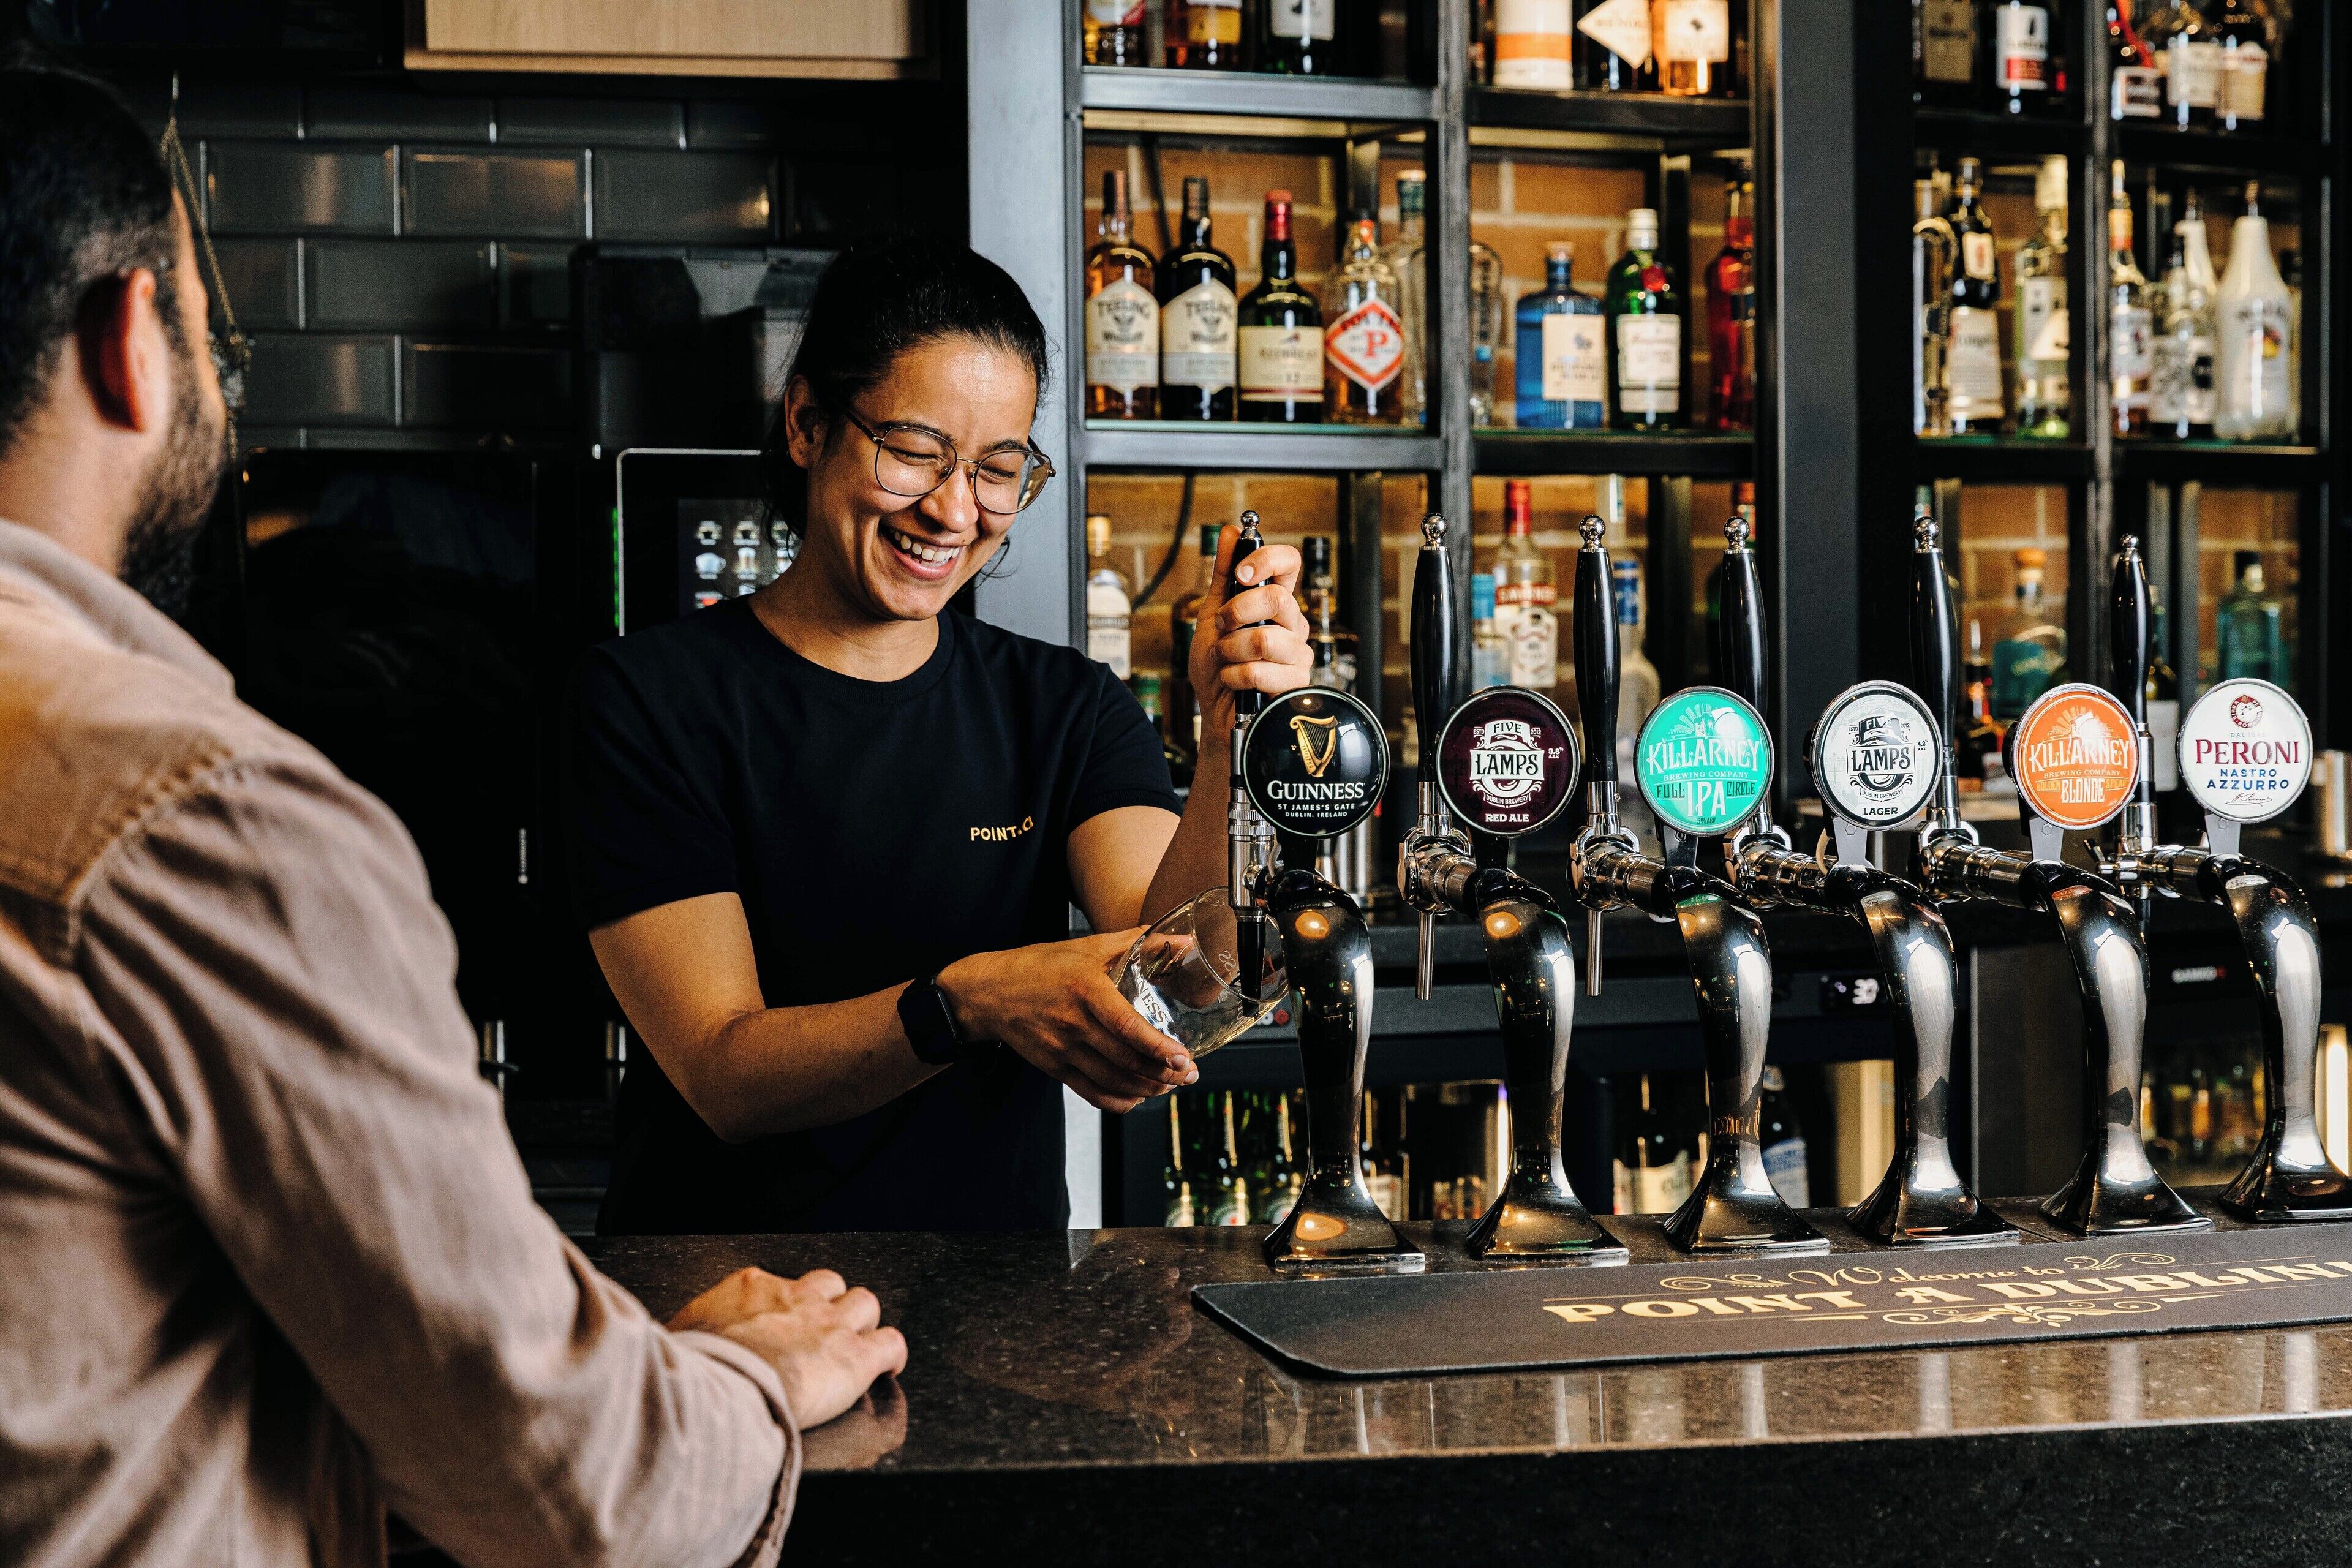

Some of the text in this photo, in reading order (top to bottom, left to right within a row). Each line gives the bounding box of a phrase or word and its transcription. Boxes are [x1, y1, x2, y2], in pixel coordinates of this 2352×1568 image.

[1493, 722, 1521, 734] FIVE
[1866, 718, 1891, 730] FIV
[1646, 738, 1760, 775] KILLARNEY
[1851, 747, 1910, 771] LAMPS
[2028, 737, 2130, 773] KILLARNEY
[2195, 739, 2299, 765] PERONI
[1475, 753, 1539, 775] LAMPS
[2220, 769, 2277, 777] NASTRO
[1664, 771, 1705, 781] BREWING
[2043, 770, 2082, 778] BREWING
[1267, 780, 1365, 800] GUINNESS
[1656, 781, 1755, 798] FULL CIRCLE
[2061, 778, 2105, 804] BLONDE
[2206, 779, 2290, 790] AZZURRO
[1486, 794, 1529, 804] DUBLIN BREWERY
[1686, 780, 1726, 816] IPA
[1862, 789, 1901, 799] DUBLIN BREWERY
[1485, 813, 1529, 822] RED ALE
[1788, 1265, 2065, 1286] Welcome to
[1542, 1291, 1867, 1322] POINT
[1895, 1286, 1975, 1304] A
